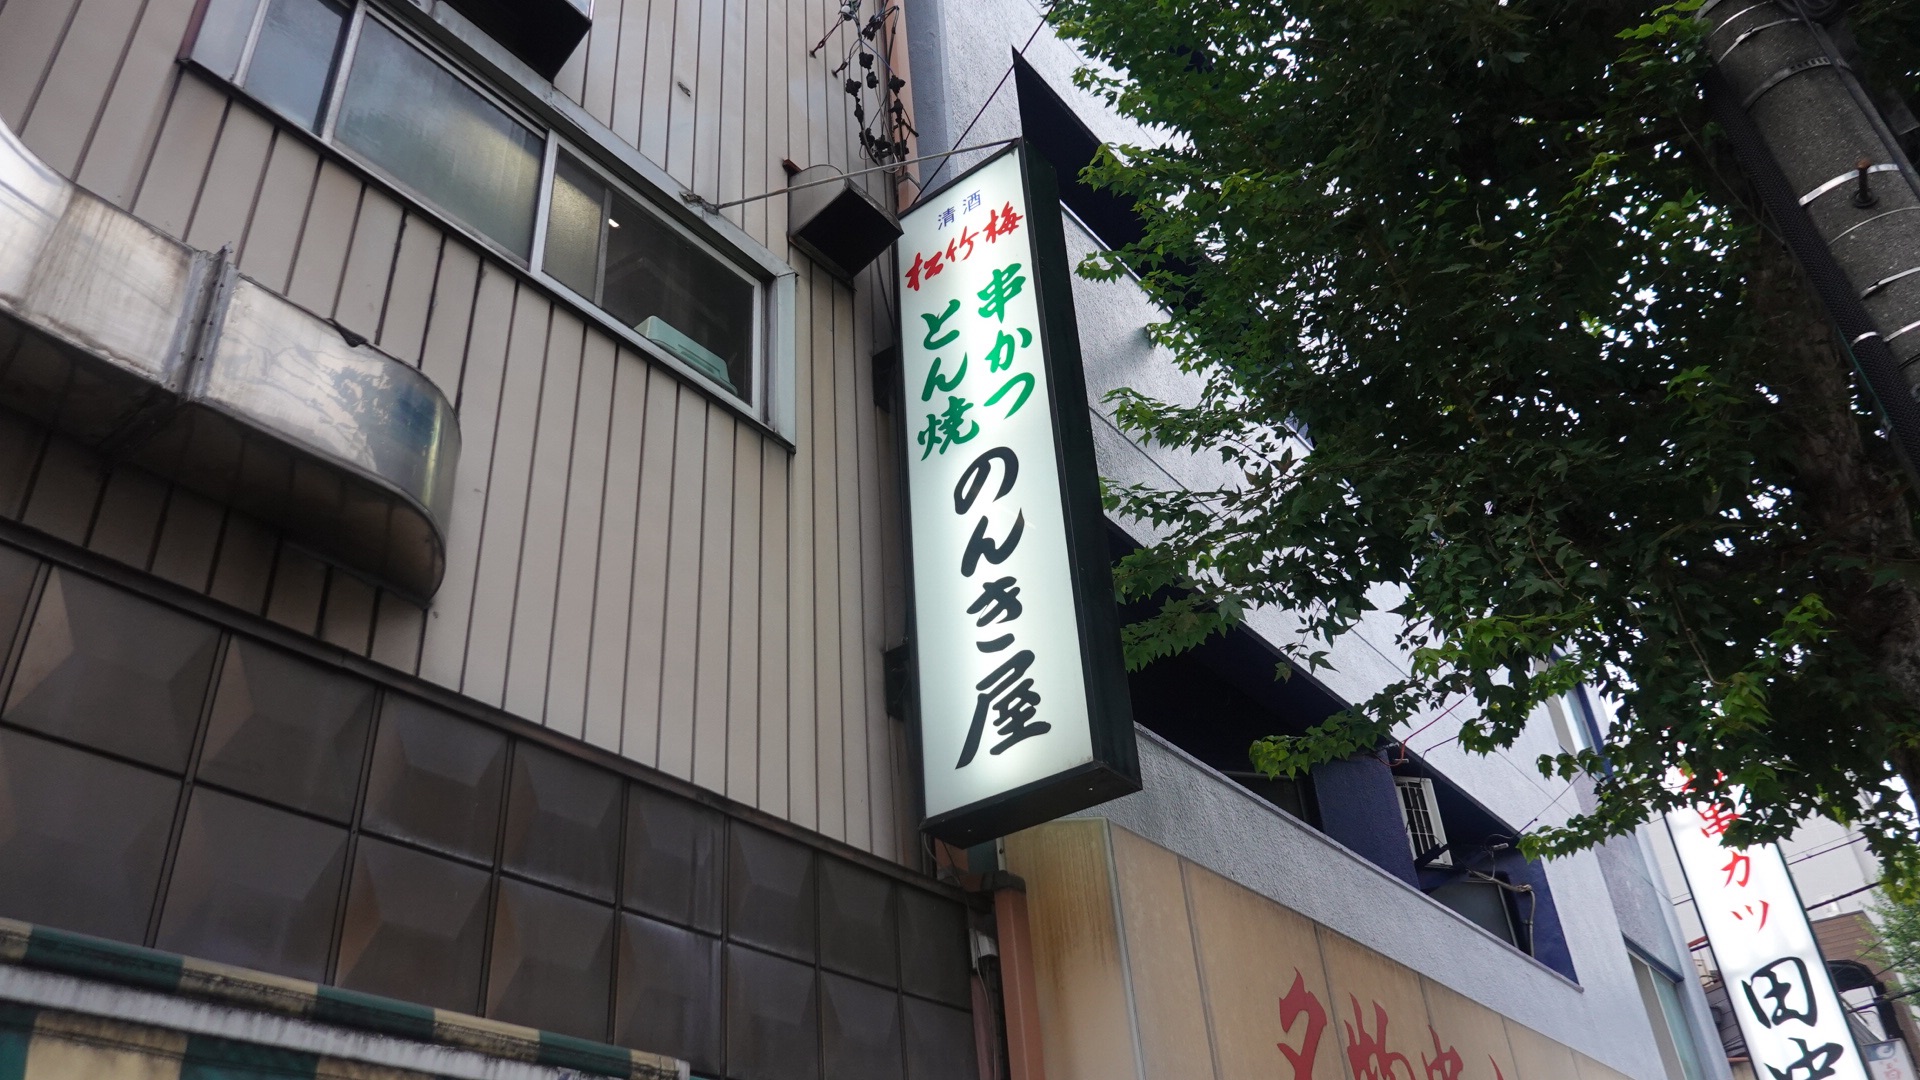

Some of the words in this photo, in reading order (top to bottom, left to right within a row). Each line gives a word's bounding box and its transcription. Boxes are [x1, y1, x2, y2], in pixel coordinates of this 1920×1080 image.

[904, 201, 1024, 292] 松竹梅
[937, 189, 981, 231] 清酒
[917, 299, 980, 461] とん焼
[976, 263, 1036, 420] 串かつ
[953, 446, 1052, 770] のんき屋
